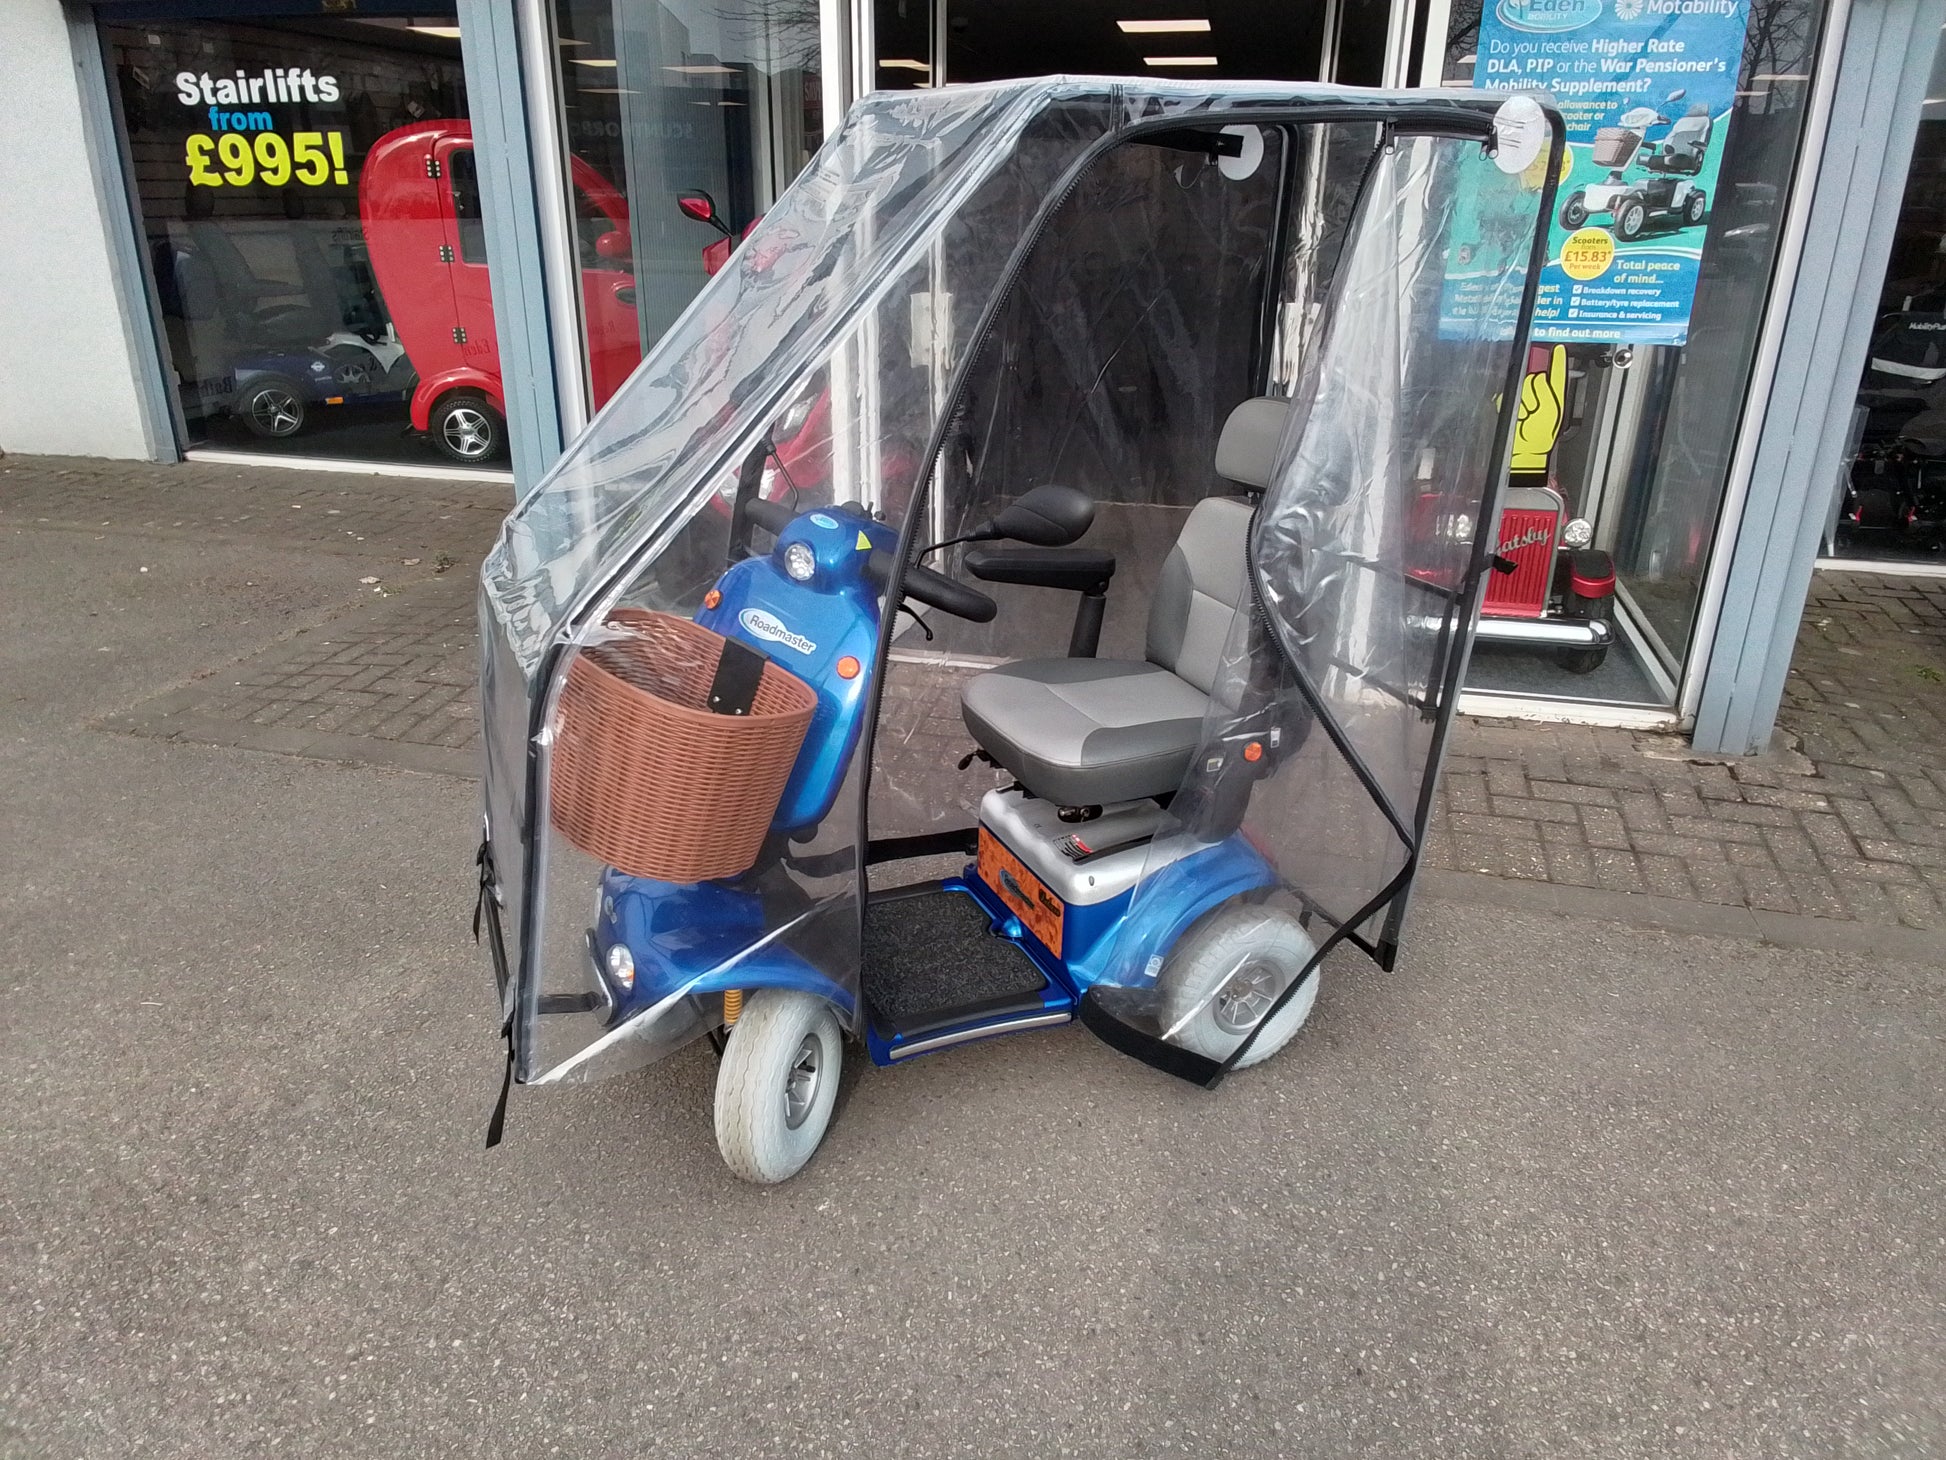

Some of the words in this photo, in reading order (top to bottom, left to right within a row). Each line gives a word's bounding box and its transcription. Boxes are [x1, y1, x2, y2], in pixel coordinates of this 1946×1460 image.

[1646, 0, 1738, 18] Motability
[1490, 40, 1511, 54] Do
[1513, 43, 1539, 56] you
[1541, 41, 1589, 54] receive
[1591, 40, 1644, 56] Higher
[1647, 39, 1685, 53] Rate
[1487, 60, 1522, 75] DLA,
[1526, 59, 1553, 73] PIP
[1557, 63, 1571, 73] or
[1573, 59, 1597, 73] the
[1601, 59, 1632, 73] War
[1636, 58, 1726, 73] Pensioner's
[176, 68, 340, 106] Stairlifts
[1551, 78, 1651, 96] Supplement?
[1558, 99, 1607, 110] allowance
[1607, 100, 1618, 110] to
[208, 106, 273, 131] from
[1563, 111, 1593, 121] cooter
[1594, 112, 1605, 121] or
[1566, 121, 1591, 132] chair
[185, 131, 349, 187] £995!
[1572, 236, 1608, 245] Scooters
[1616, 260, 1646, 270] Total
[1647, 261, 1681, 272] peace
[1614, 274, 1626, 284] of
[1538, 284, 1560, 294] gest
[1583, 286, 1627, 295] Breakdown
[1628, 288, 1661, 297] recovery
[1536, 296, 1552, 305] ler
[1553, 296, 1563, 305] in
[1581, 298, 1629, 308] Battery/tyre
[1630, 299, 1680, 309] replacement
[1579, 310, 1618, 319] Insurance
[1618, 310, 1626, 319] &
[1626, 310, 1662, 320] servicing
[1533, 327, 1546, 337] to
[1548, 326, 1570, 337] find
[1572, 327, 1590, 337] out
[1593, 329, 1622, 338] more
[1497, 526, 1552, 556] atsby
[748, 613, 816, 653] Roadmaster
